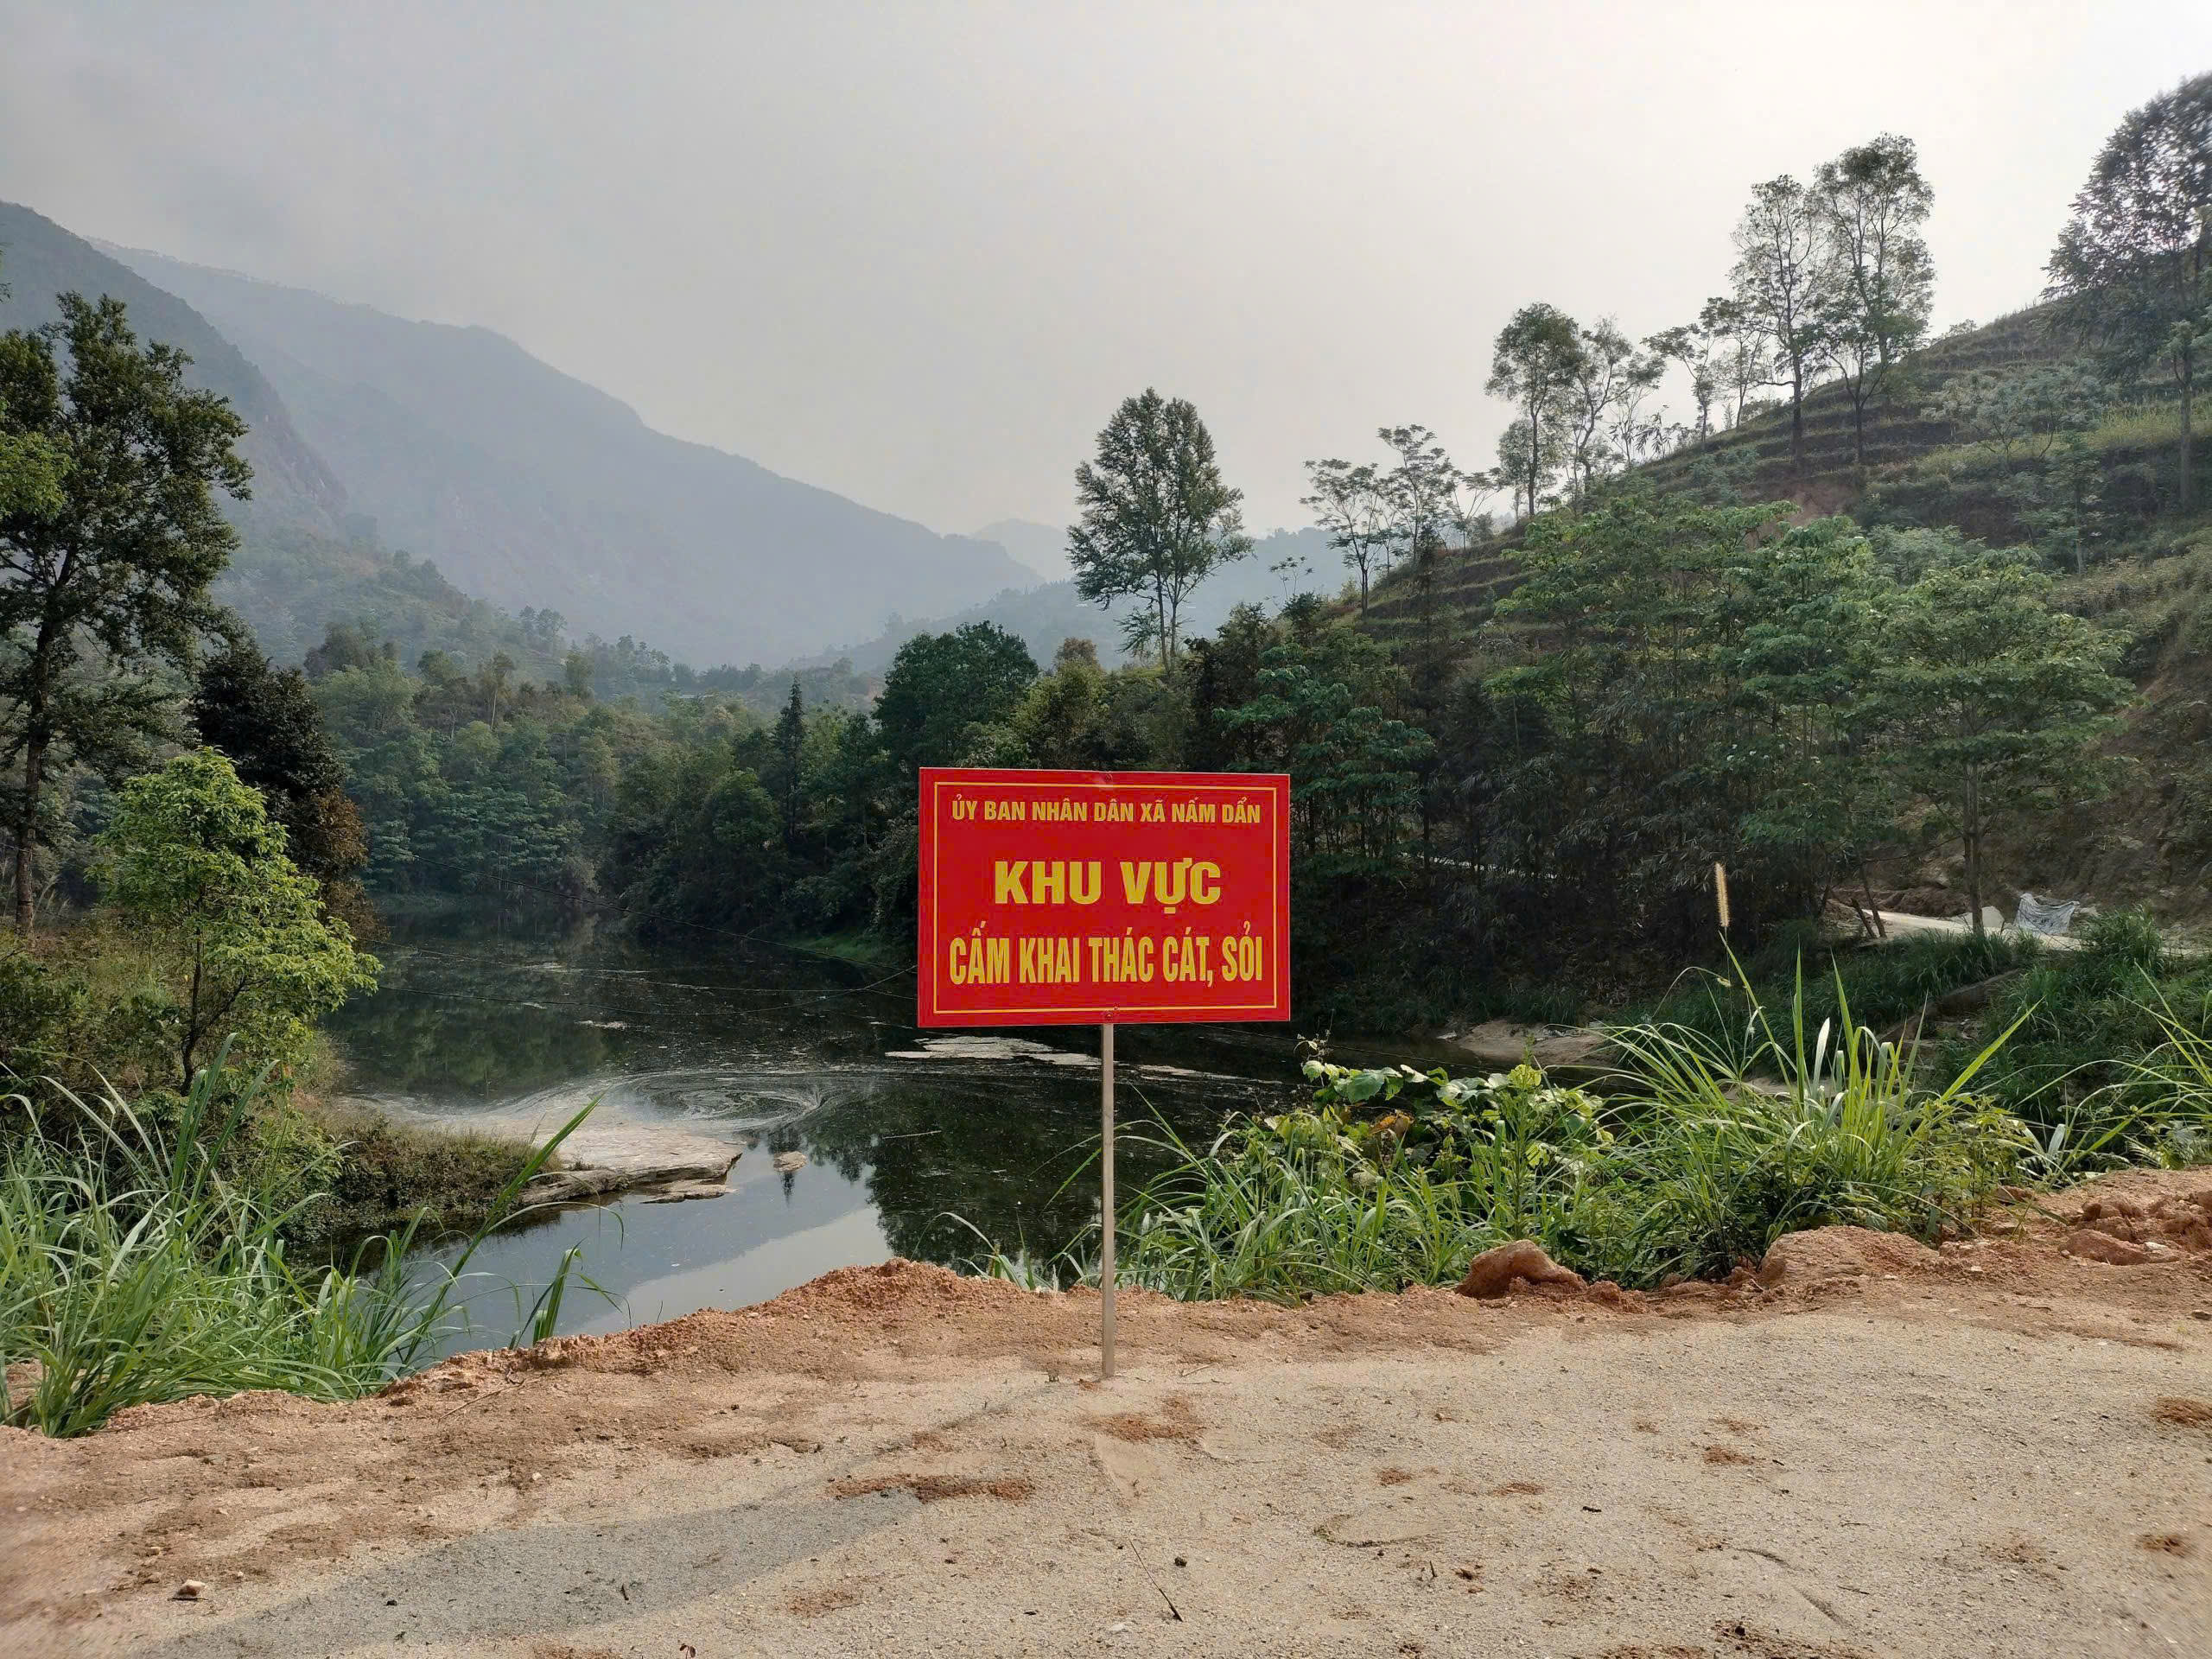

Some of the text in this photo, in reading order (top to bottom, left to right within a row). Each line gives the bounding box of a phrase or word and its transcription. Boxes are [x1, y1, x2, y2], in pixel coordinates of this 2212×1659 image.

[952, 794, 1261, 823] ỦY BAN NHÂN DÂN XÃ NẤM DẨN
[995, 857, 1221, 914] KHU VỰC
[950, 920, 1262, 988] CẤM KHAI THÁC CÁT, SỎI
